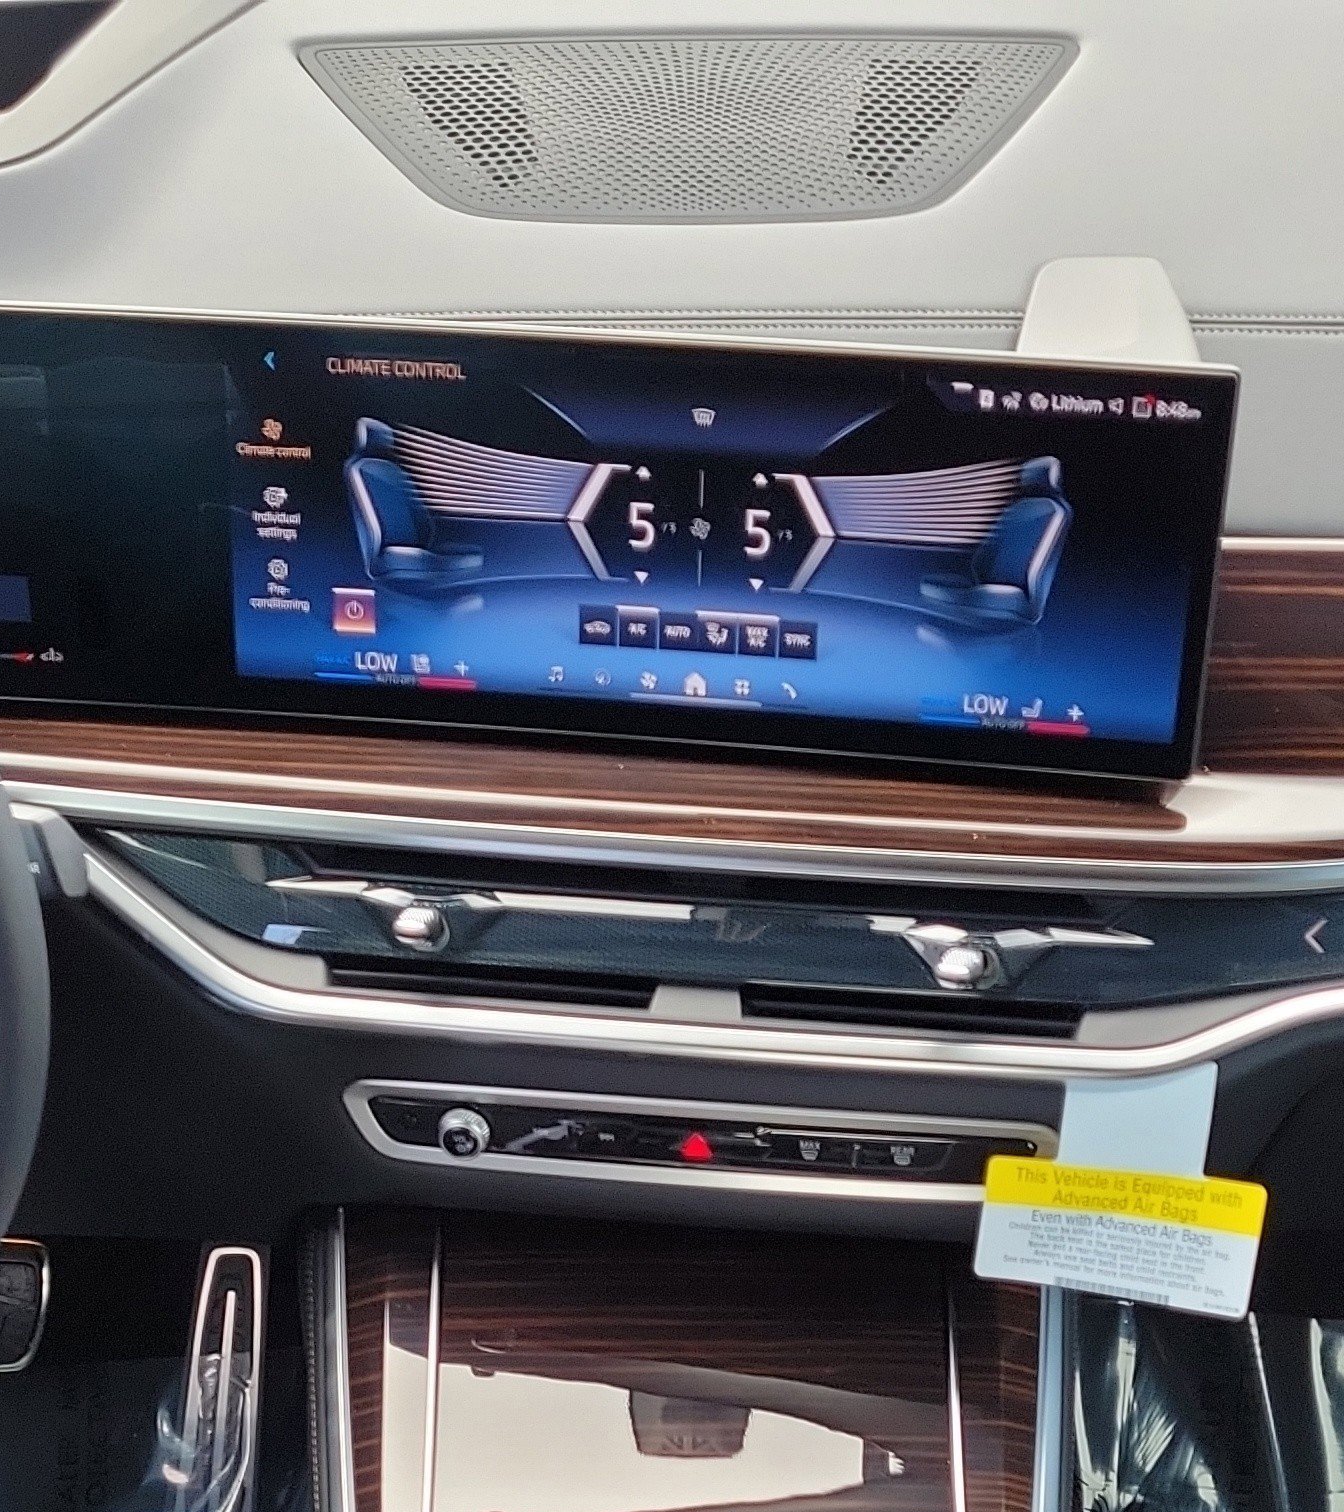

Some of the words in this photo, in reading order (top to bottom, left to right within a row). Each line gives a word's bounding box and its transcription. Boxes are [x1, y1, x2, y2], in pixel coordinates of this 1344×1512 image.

[326, 357, 392, 376] CLIMATE
[393, 360, 467, 381] CONTROL
[1051, 394, 1104, 414] Lithium
[628, 502, 655, 549] 5
[744, 509, 771, 556] 5
[354, 652, 398, 672] LOW
[962, 693, 1009, 716] LOW
[1015, 1166, 1047, 1185] This
[1052, 1169, 1109, 1191] Vehicle
[1113, 1175, 1128, 1191] is
[1131, 1177, 1204, 1203] Equipped
[1209, 1189, 1243, 1209] with
[1052, 1187, 1128, 1212] Advanced
[1133, 1196, 1155, 1213] Air
[1159, 1201, 1199, 1224] Bags
[1030, 1209, 1062, 1225] Even
[1065, 1213, 1091, 1228] with
[1094, 1216, 1158, 1237] Advanced
[1159, 1226, 1178, 1240] Air
[1181, 1229, 1212, 1246] Bags
